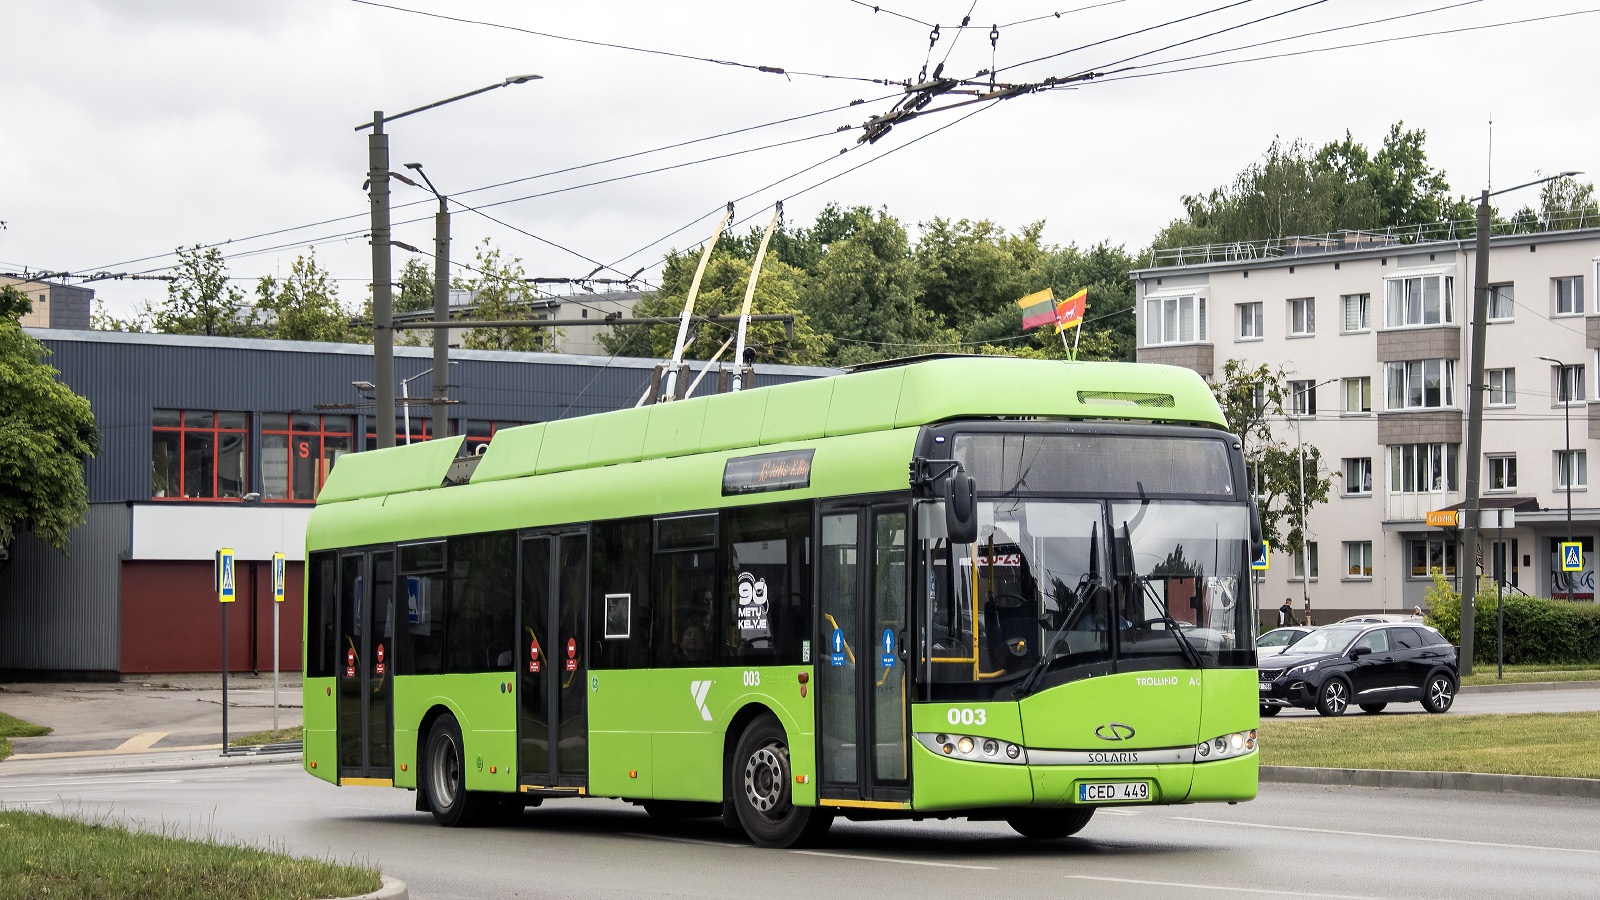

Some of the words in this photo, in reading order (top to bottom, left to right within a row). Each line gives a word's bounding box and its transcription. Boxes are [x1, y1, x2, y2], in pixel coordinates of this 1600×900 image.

[299, 442, 310, 458] S
[738, 581, 768, 606] 90
[738, 606, 762, 620] METŲ
[738, 619, 767, 629] KELYJE
[743, 670, 761, 686] 003
[1136, 676, 1179, 686] TROLLINO
[947, 708, 987, 726] 003
[1088, 752, 1138, 763] SOLARIS
[1088, 785, 1115, 799] CED
[1124, 784, 1147, 798] 449
